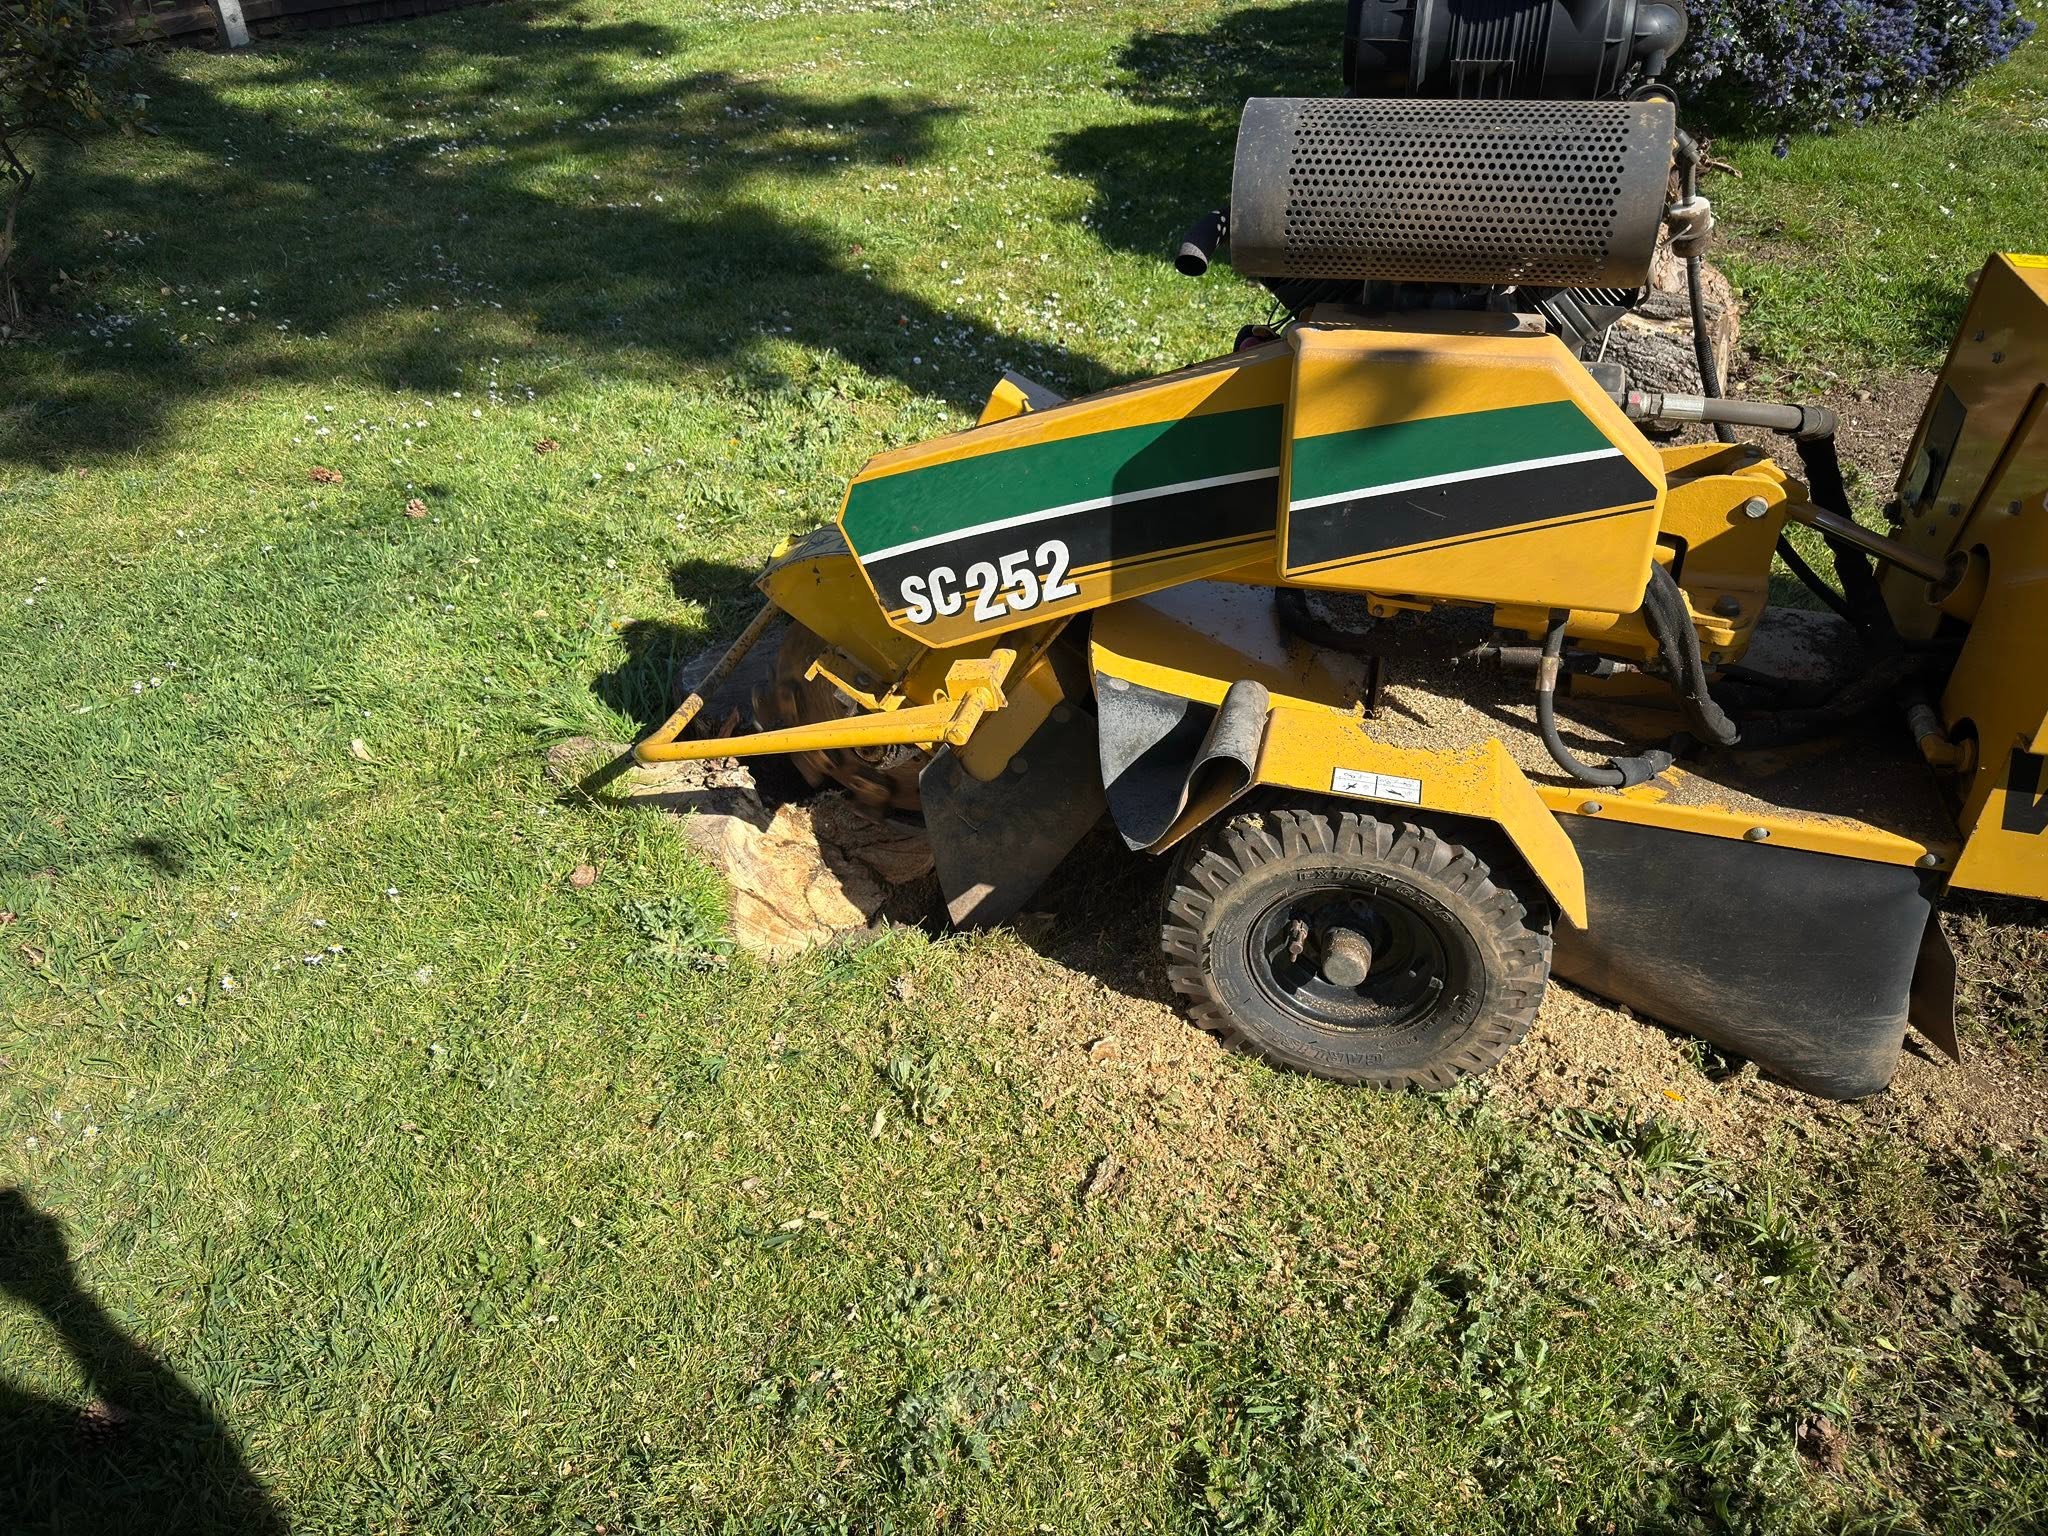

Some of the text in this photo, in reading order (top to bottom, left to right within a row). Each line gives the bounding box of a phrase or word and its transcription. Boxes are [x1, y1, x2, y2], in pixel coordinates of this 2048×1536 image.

[965, 539, 1080, 623] 252
[1297, 869, 1455, 924] EXTRA GRIP
